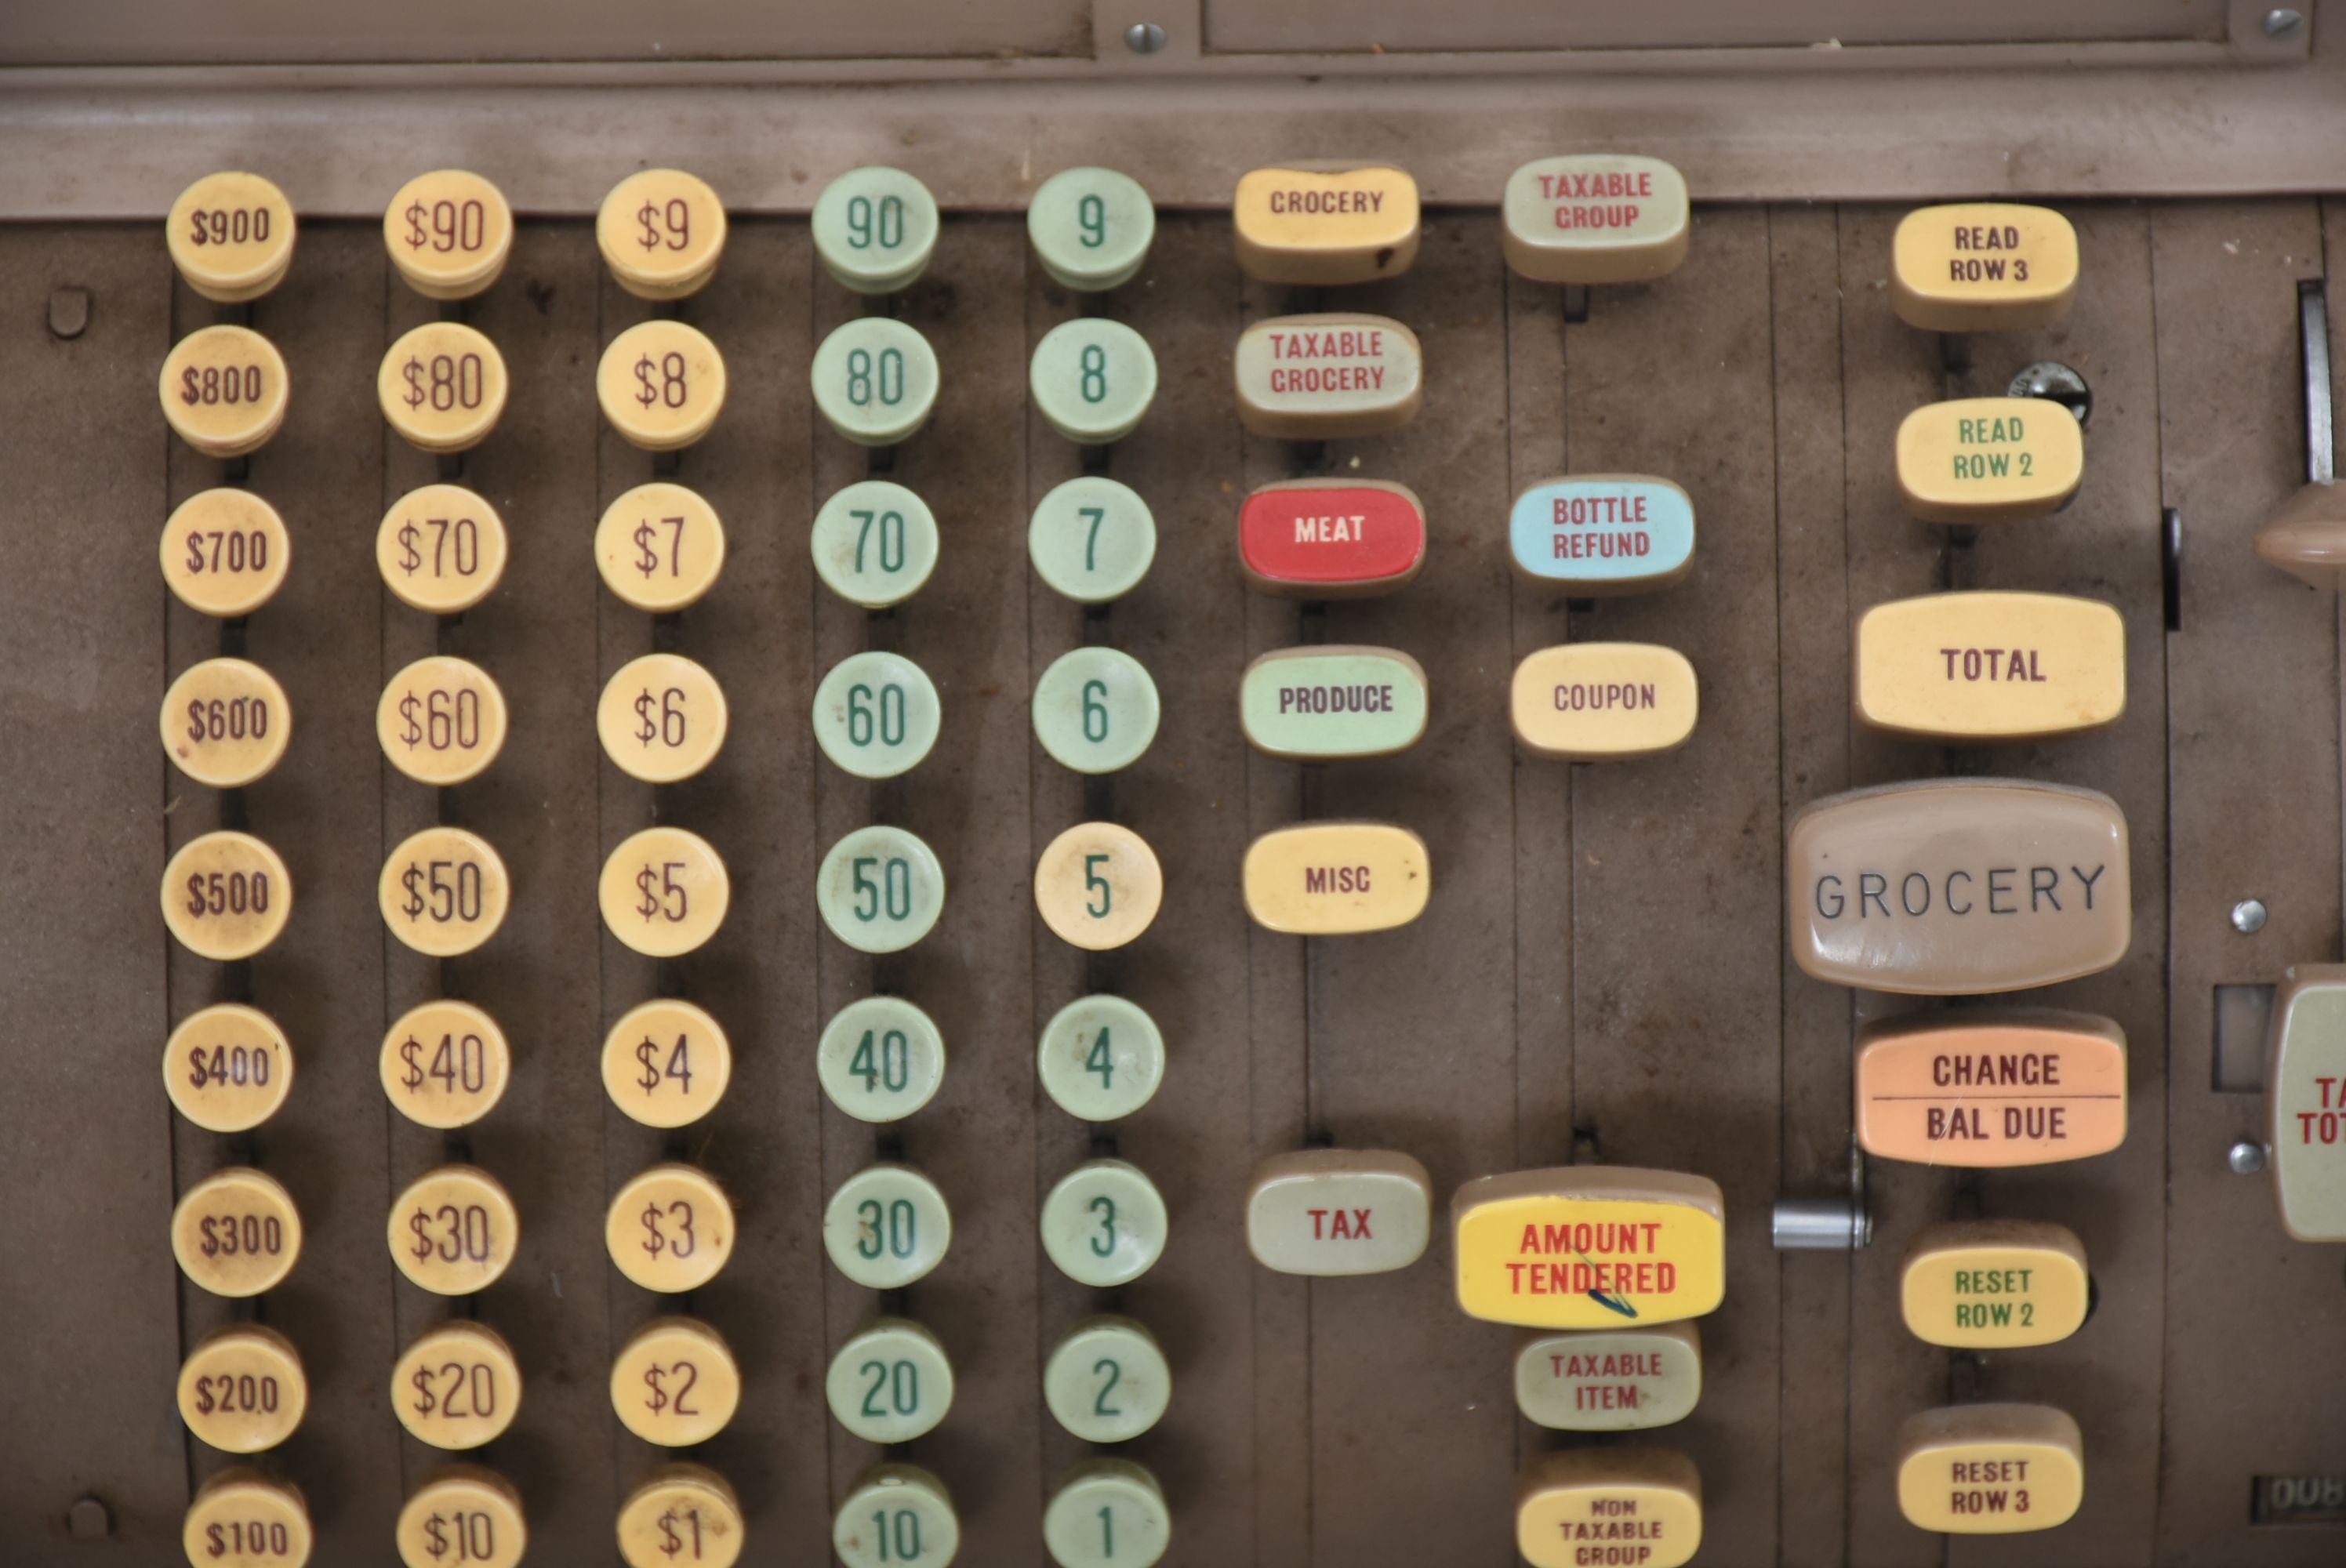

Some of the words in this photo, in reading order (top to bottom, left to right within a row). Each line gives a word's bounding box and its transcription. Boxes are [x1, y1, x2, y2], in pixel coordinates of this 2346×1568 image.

[1270, 191, 1383, 214] GROCERY
[1538, 172, 1651, 199] TAXABLE
[191, 207, 270, 246] $900
[405, 199, 485, 253] $90
[637, 198, 690, 252] $9
[848, 194, 905, 249] 90
[1079, 194, 1105, 249] 9
[1555, 205, 1640, 230] GROUP
[1955, 226, 2019, 251] READ
[1950, 259, 2006, 282] ROW
[2014, 259, 2028, 281] 3
[1269, 331, 1383, 360] TAXABLE
[181, 365, 262, 406] $800
[402, 352, 483, 412] $80
[634, 351, 687, 409] $8
[848, 347, 904, 407] 80
[1080, 344, 1107, 404] 8
[1270, 365, 1385, 394] GROCERY
[1959, 416, 2024, 444] READ
[1953, 452, 2010, 479] ROW
[2018, 452, 2032, 477] 2
[1294, 515, 1367, 543] MEAT
[1553, 495, 1647, 525] BOTTLE
[187, 530, 267, 574] $700
[398, 518, 478, 578] $70
[634, 516, 685, 579] $7
[849, 510, 905, 574] 70
[1078, 507, 1105, 572] 7
[1552, 531, 1651, 559] REFUND
[1940, 648, 2046, 682] TOTAL
[187, 696, 267, 743] $600
[399, 688, 480, 751] $60
[634, 687, 686, 748] $6
[848, 683, 905, 747] 60
[1081, 679, 1108, 743] 6
[1279, 684, 1393, 714] PRODUCE
[1554, 683, 1655, 712] COUPON
[187, 871, 268, 918] $500
[401, 861, 482, 923] $50
[636, 862, 688, 923] $5
[852, 855, 910, 922] 50
[1084, 854, 1111, 919] 5
[1306, 866, 1371, 894] MISC
[1815, 864, 2105, 920] GROCERY
[188, 1045, 269, 1090] $400
[400, 1033, 485, 1094] $40
[636, 1033, 692, 1095] $4
[849, 1029, 908, 1093] 40
[1084, 1026, 1114, 1089] 4
[1933, 1053, 2060, 1087] CHANGE
[1927, 1107, 1989, 1141] BAL
[2004, 1106, 2066, 1140] DUE
[200, 1214, 281, 1259] $300
[409, 1204, 490, 1264] $30
[641, 1200, 695, 1260] $3
[857, 1199, 915, 1259] 30
[1088, 1196, 1117, 1257] 3
[1307, 1208, 1371, 1240] TAX
[1520, 1222, 1661, 1255] AMOUNT
[1505, 1261, 1676, 1295] TENDERED
[1955, 1269, 2032, 1294] RESET
[1956, 1302, 2013, 1329] ROW
[2020, 1302, 2034, 1327] 2
[644, 1361, 699, 1416] $2
[860, 1359, 918, 1417] 20
[1093, 1359, 1121, 1417] 2
[1549, 1353, 1662, 1377] TAXABLE
[195, 1374, 278, 1416] $200
[412, 1362, 496, 1418] $20
[1576, 1385, 1638, 1410] ITEM
[1952, 1460, 2028, 1483] RESET
[1591, 1499, 1636, 1517] NON
[1951, 1490, 2008, 1514] ROW
[2014, 1489, 2030, 1513] 3
[206, 1521, 288, 1559] $100
[423, 1511, 494, 1561] $10
[657, 1508, 702, 1559] $1
[872, 1509, 922, 1563] 10
[1098, 1506, 1113, 1559] 1
[1560, 1521, 1661, 1540] TAXABLE
[1575, 1545, 1651, 1566] GROUP
